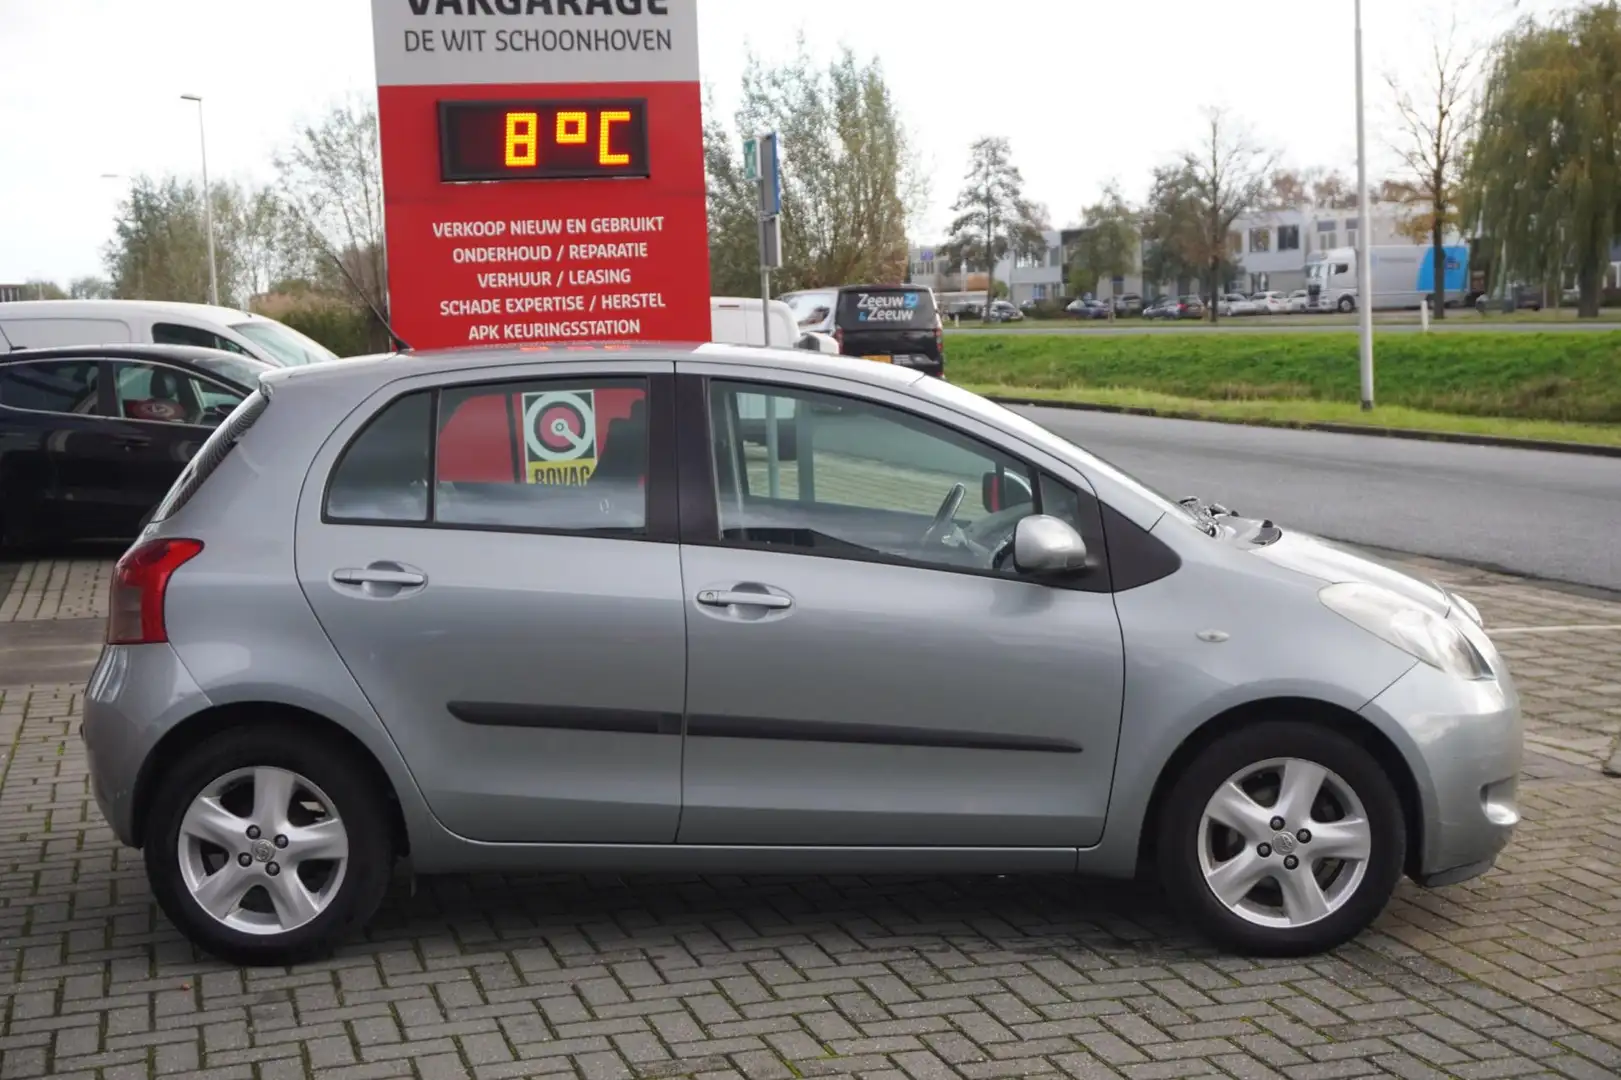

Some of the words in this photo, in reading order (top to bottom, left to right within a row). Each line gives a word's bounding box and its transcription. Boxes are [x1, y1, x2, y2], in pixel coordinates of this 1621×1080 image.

[404, 30, 434, 51] DE
[442, 30, 486, 51] WIT
[495, 29, 671, 51] SCHOONHOVEN
[433, 221, 505, 238] VERKOOP
[510, 219, 562, 236] NIEUW
[567, 219, 586, 233] EN
[591, 216, 664, 233] GEBRUIKT
[453, 246, 552, 263] ONDERHOUD
[556, 245, 564, 261] /
[569, 242, 648, 260] REPARATIE
[477, 271, 551, 288] VERHUUR
[556, 271, 564, 287] /
[569, 268, 631, 285] LEASING
[440, 299, 500, 316] SCHADE
[505, 296, 584, 313] EXPERTISE
[589, 296, 597, 311] /
[601, 293, 665, 309] HERSTEL
[857, 293, 904, 308] Zeeuw
[867, 307, 914, 321] Zeeuw
[469, 325, 499, 340] APK
[504, 319, 640, 338] KEURINGSSTATION
